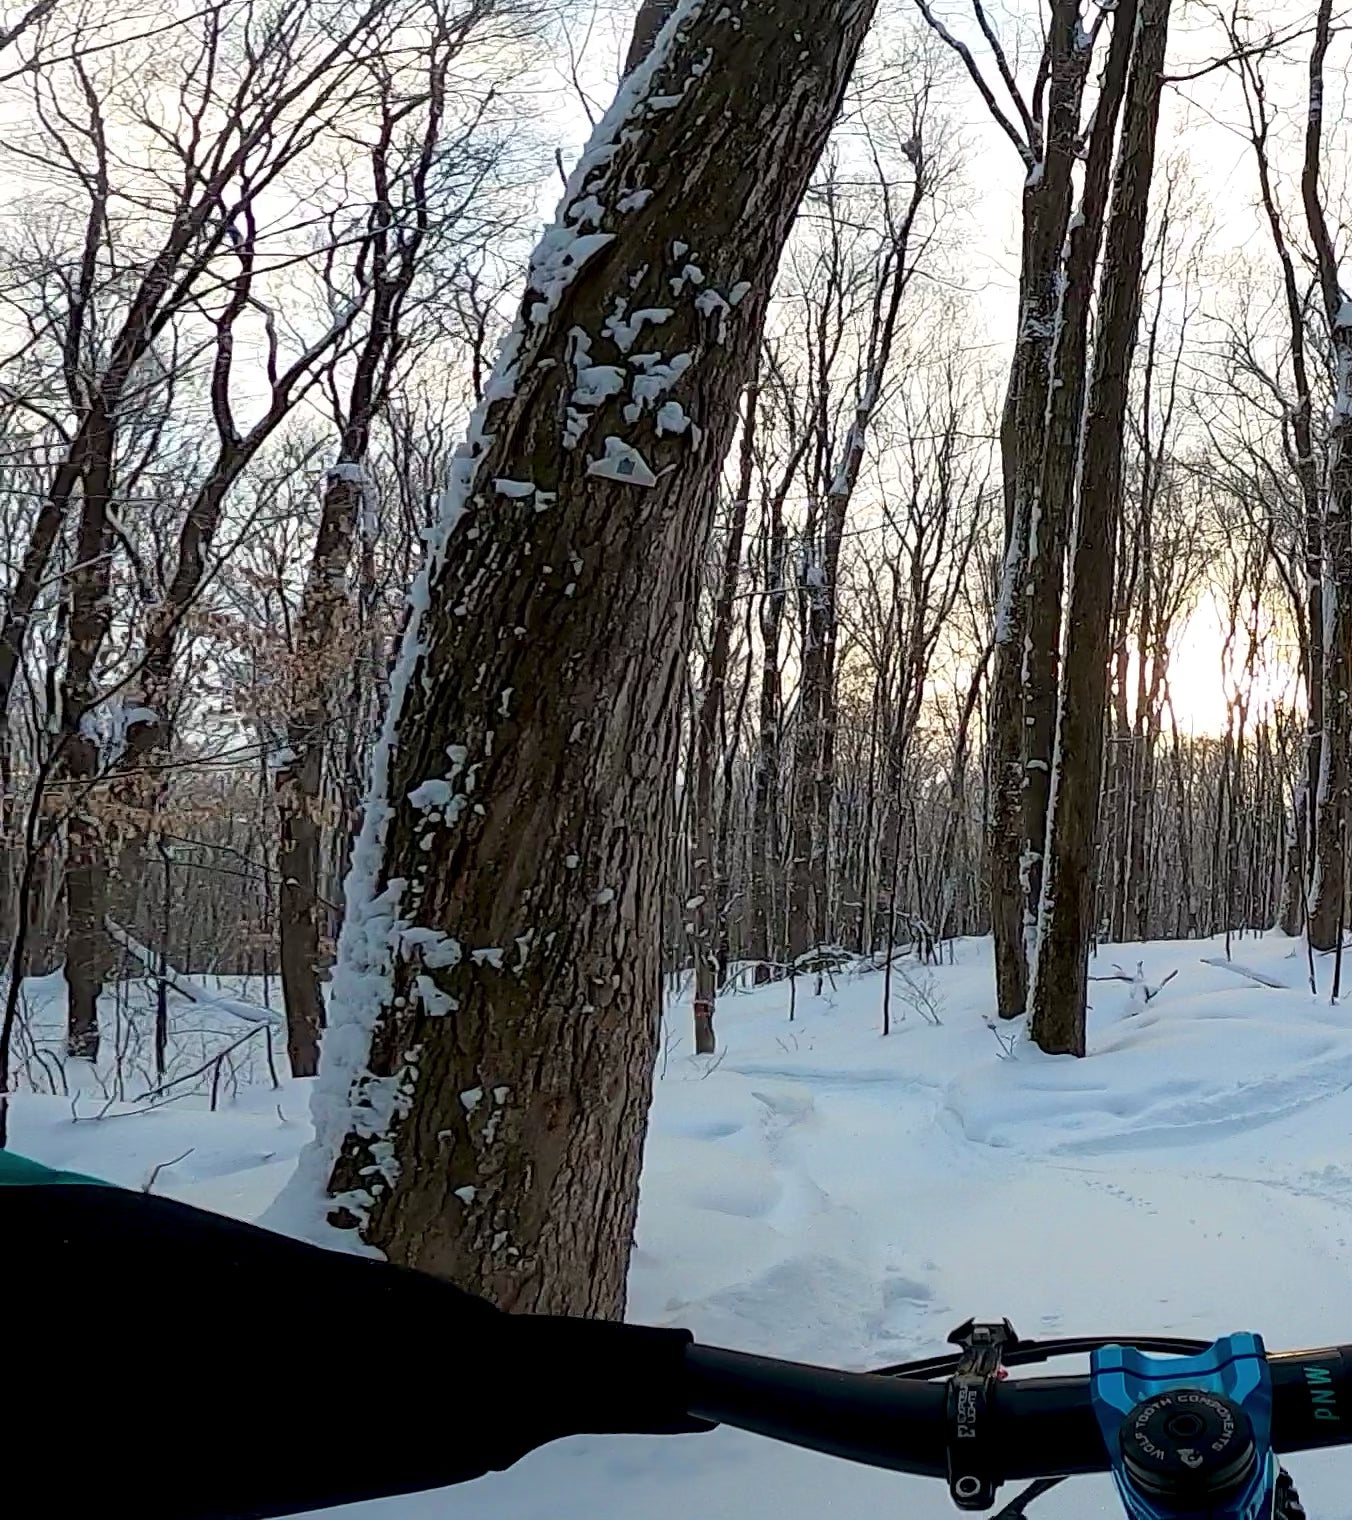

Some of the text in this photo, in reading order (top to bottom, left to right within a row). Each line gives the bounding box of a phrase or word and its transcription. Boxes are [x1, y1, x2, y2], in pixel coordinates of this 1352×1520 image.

[1303, 1365, 1341, 1421] PNW
[1134, 1394, 1235, 1461] WOLF TOOTH COMPONENTS
